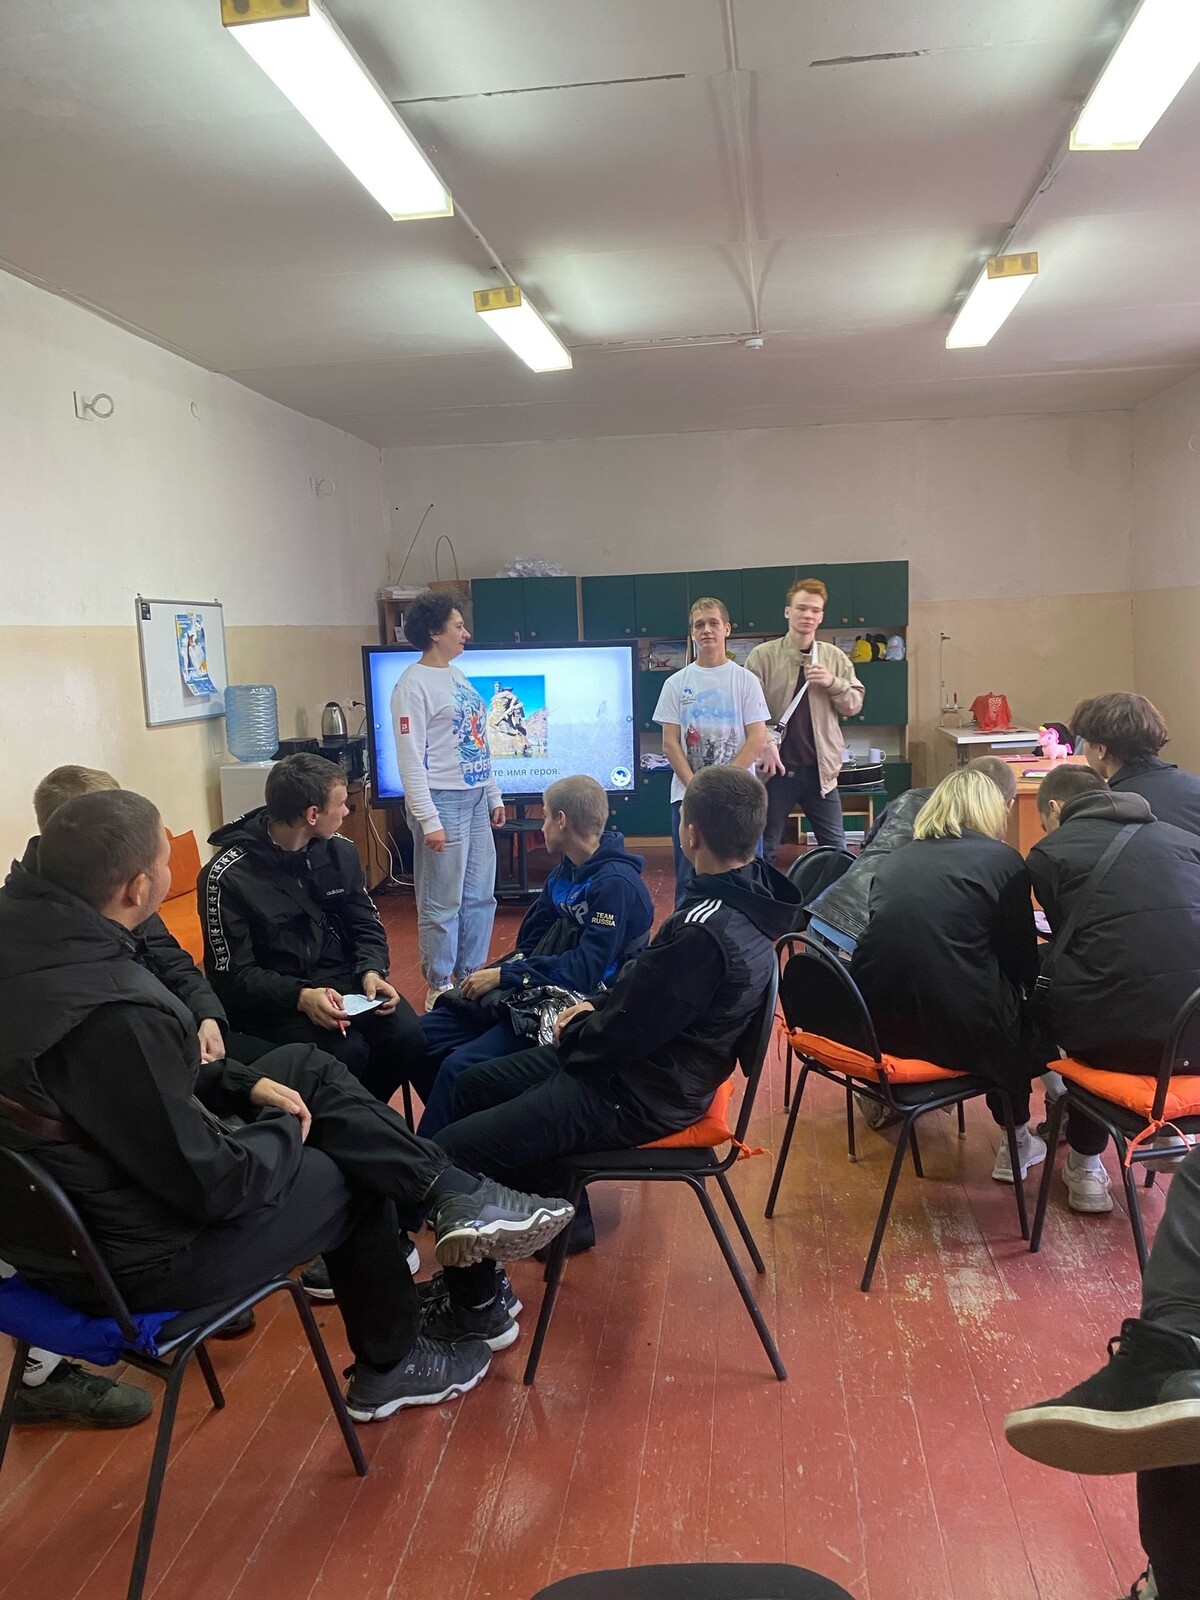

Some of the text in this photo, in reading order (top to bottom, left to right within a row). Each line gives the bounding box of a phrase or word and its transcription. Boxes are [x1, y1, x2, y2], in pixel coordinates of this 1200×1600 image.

[530, 768, 560, 777] героя.
[596, 911, 615, 920] TEAM
[591, 917, 616, 927] RUSSIA
